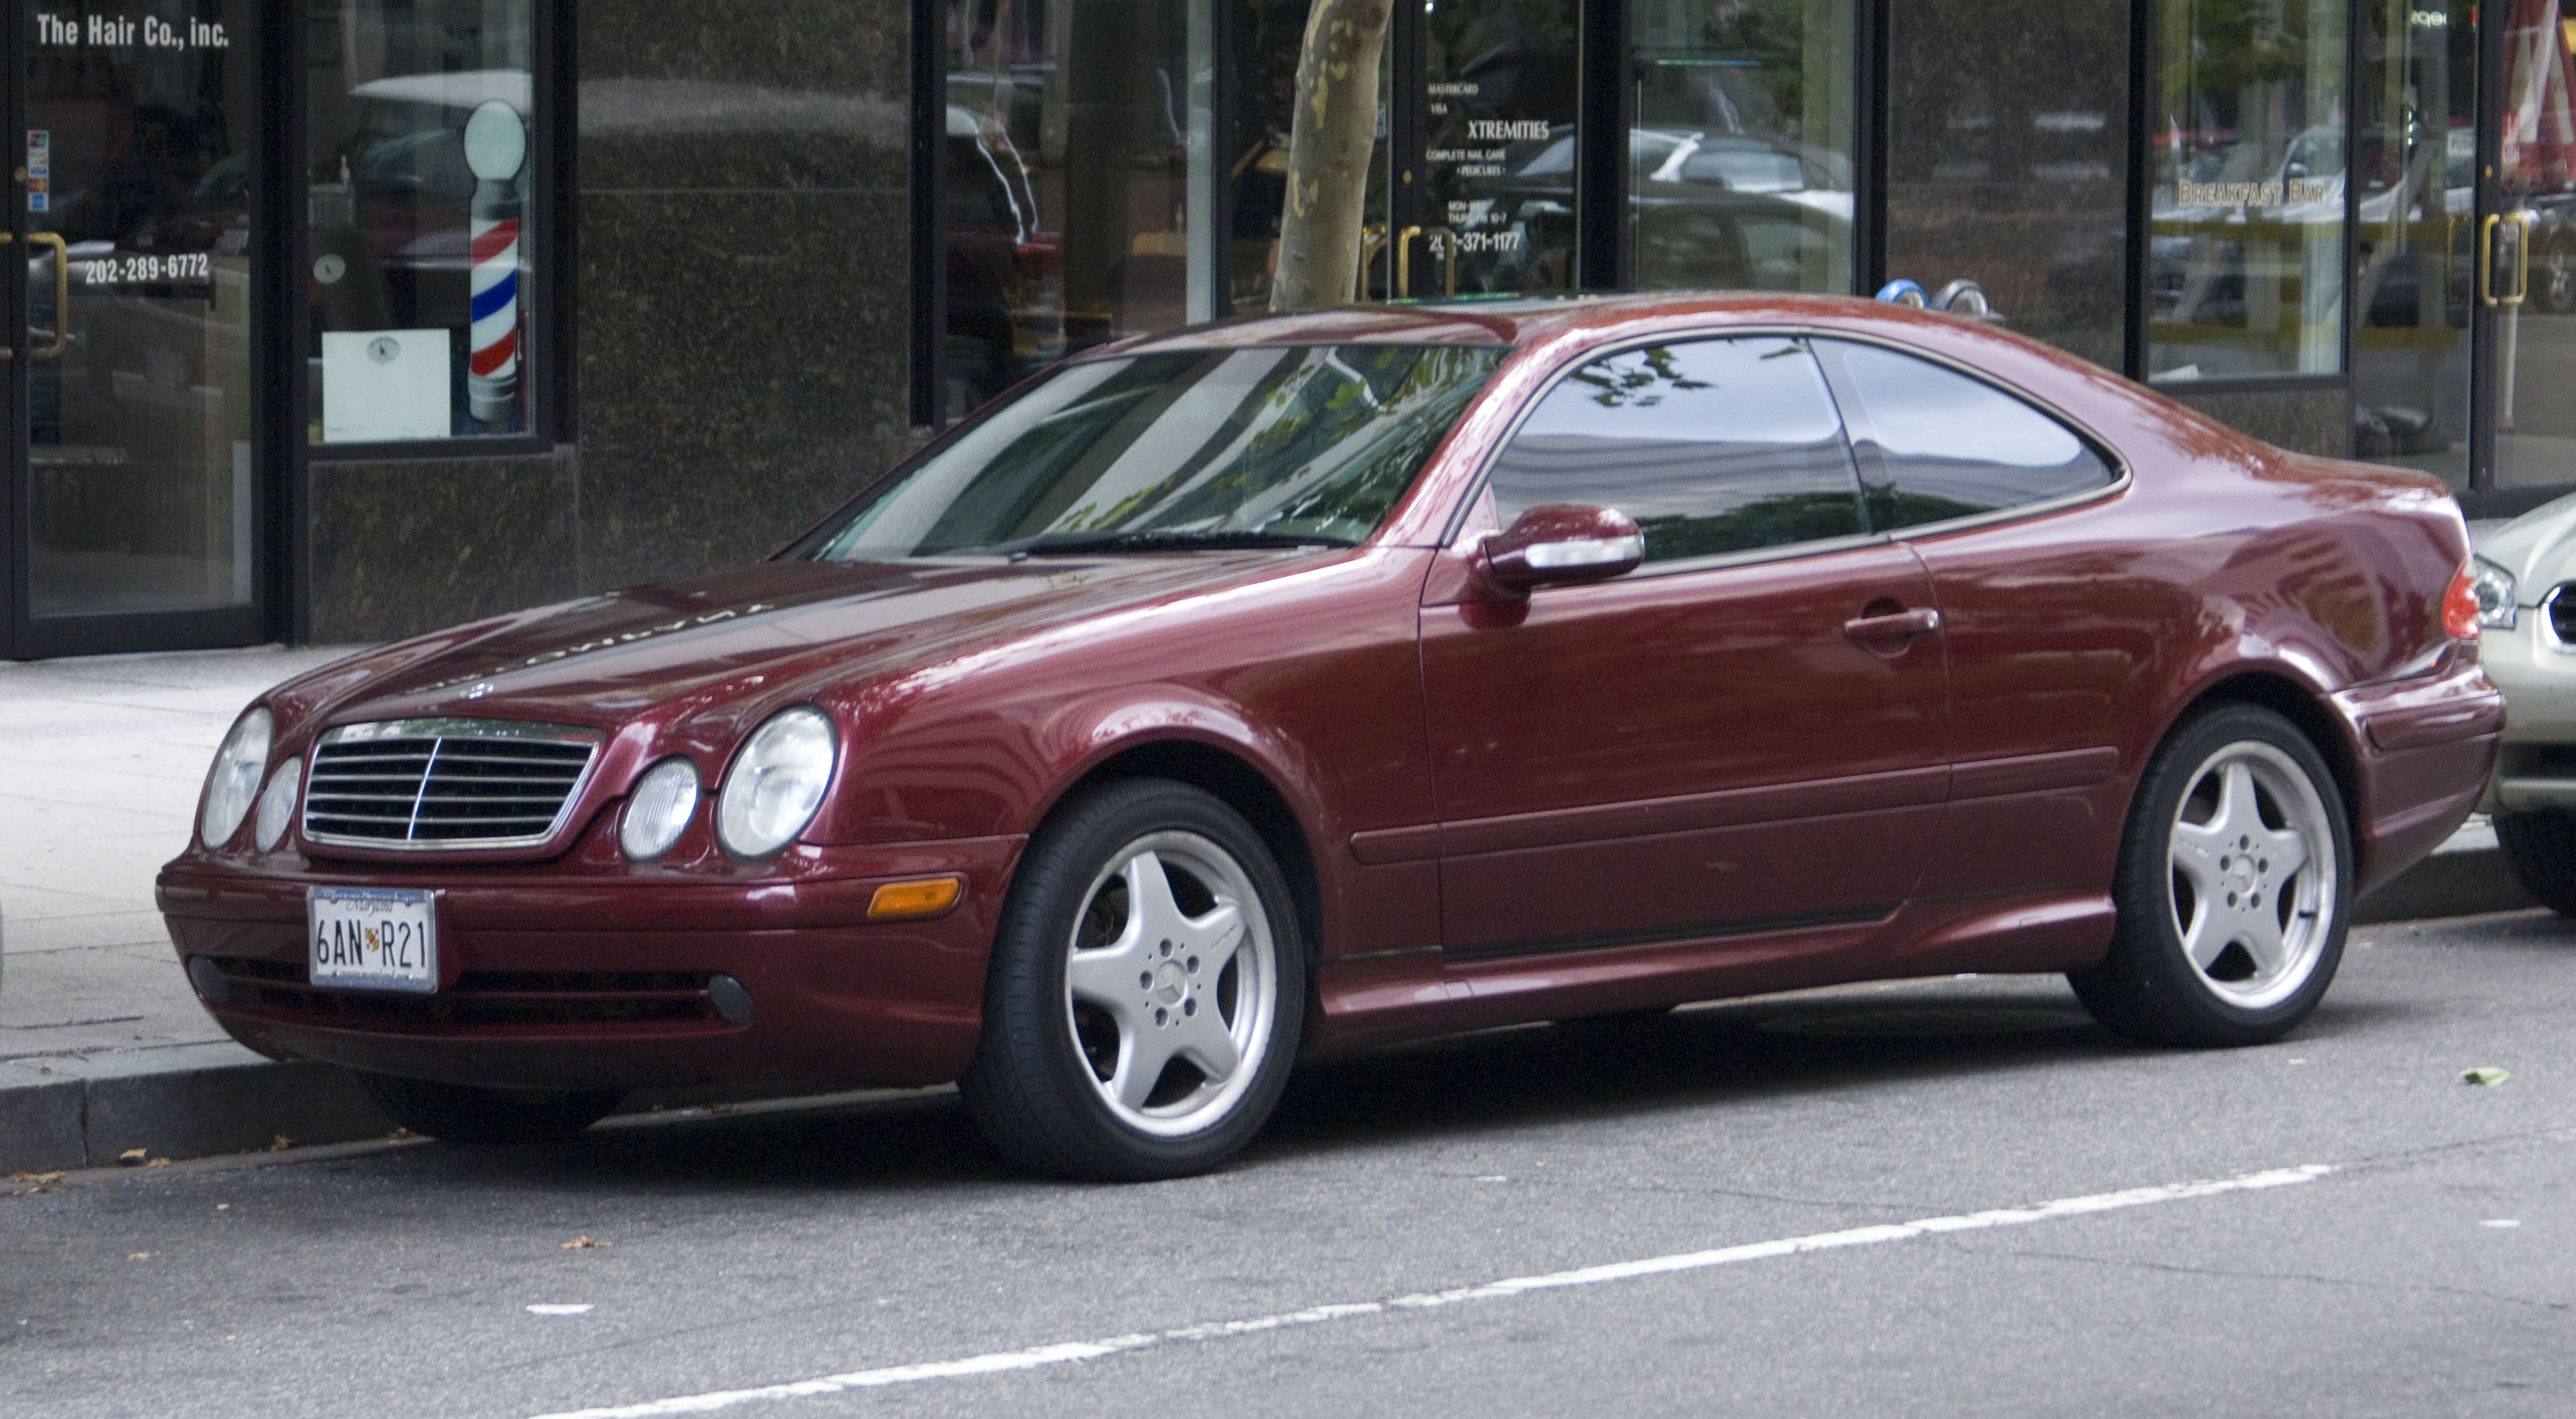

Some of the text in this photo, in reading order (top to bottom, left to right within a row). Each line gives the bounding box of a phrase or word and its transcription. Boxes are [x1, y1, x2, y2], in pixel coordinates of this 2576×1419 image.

[37, 13, 229, 51] The Hair Co., inc.
[1428, 83, 1479, 95] MASTERCARD
[1467, 119, 1550, 140] XTREMITIES
[1426, 149, 1506, 161] COMPLETE NAIL CARE
[85, 253, 208, 284] 202-289-6772
[346, 899, 394, 916] Maryland
[317, 919, 426, 968] 6AN R21
